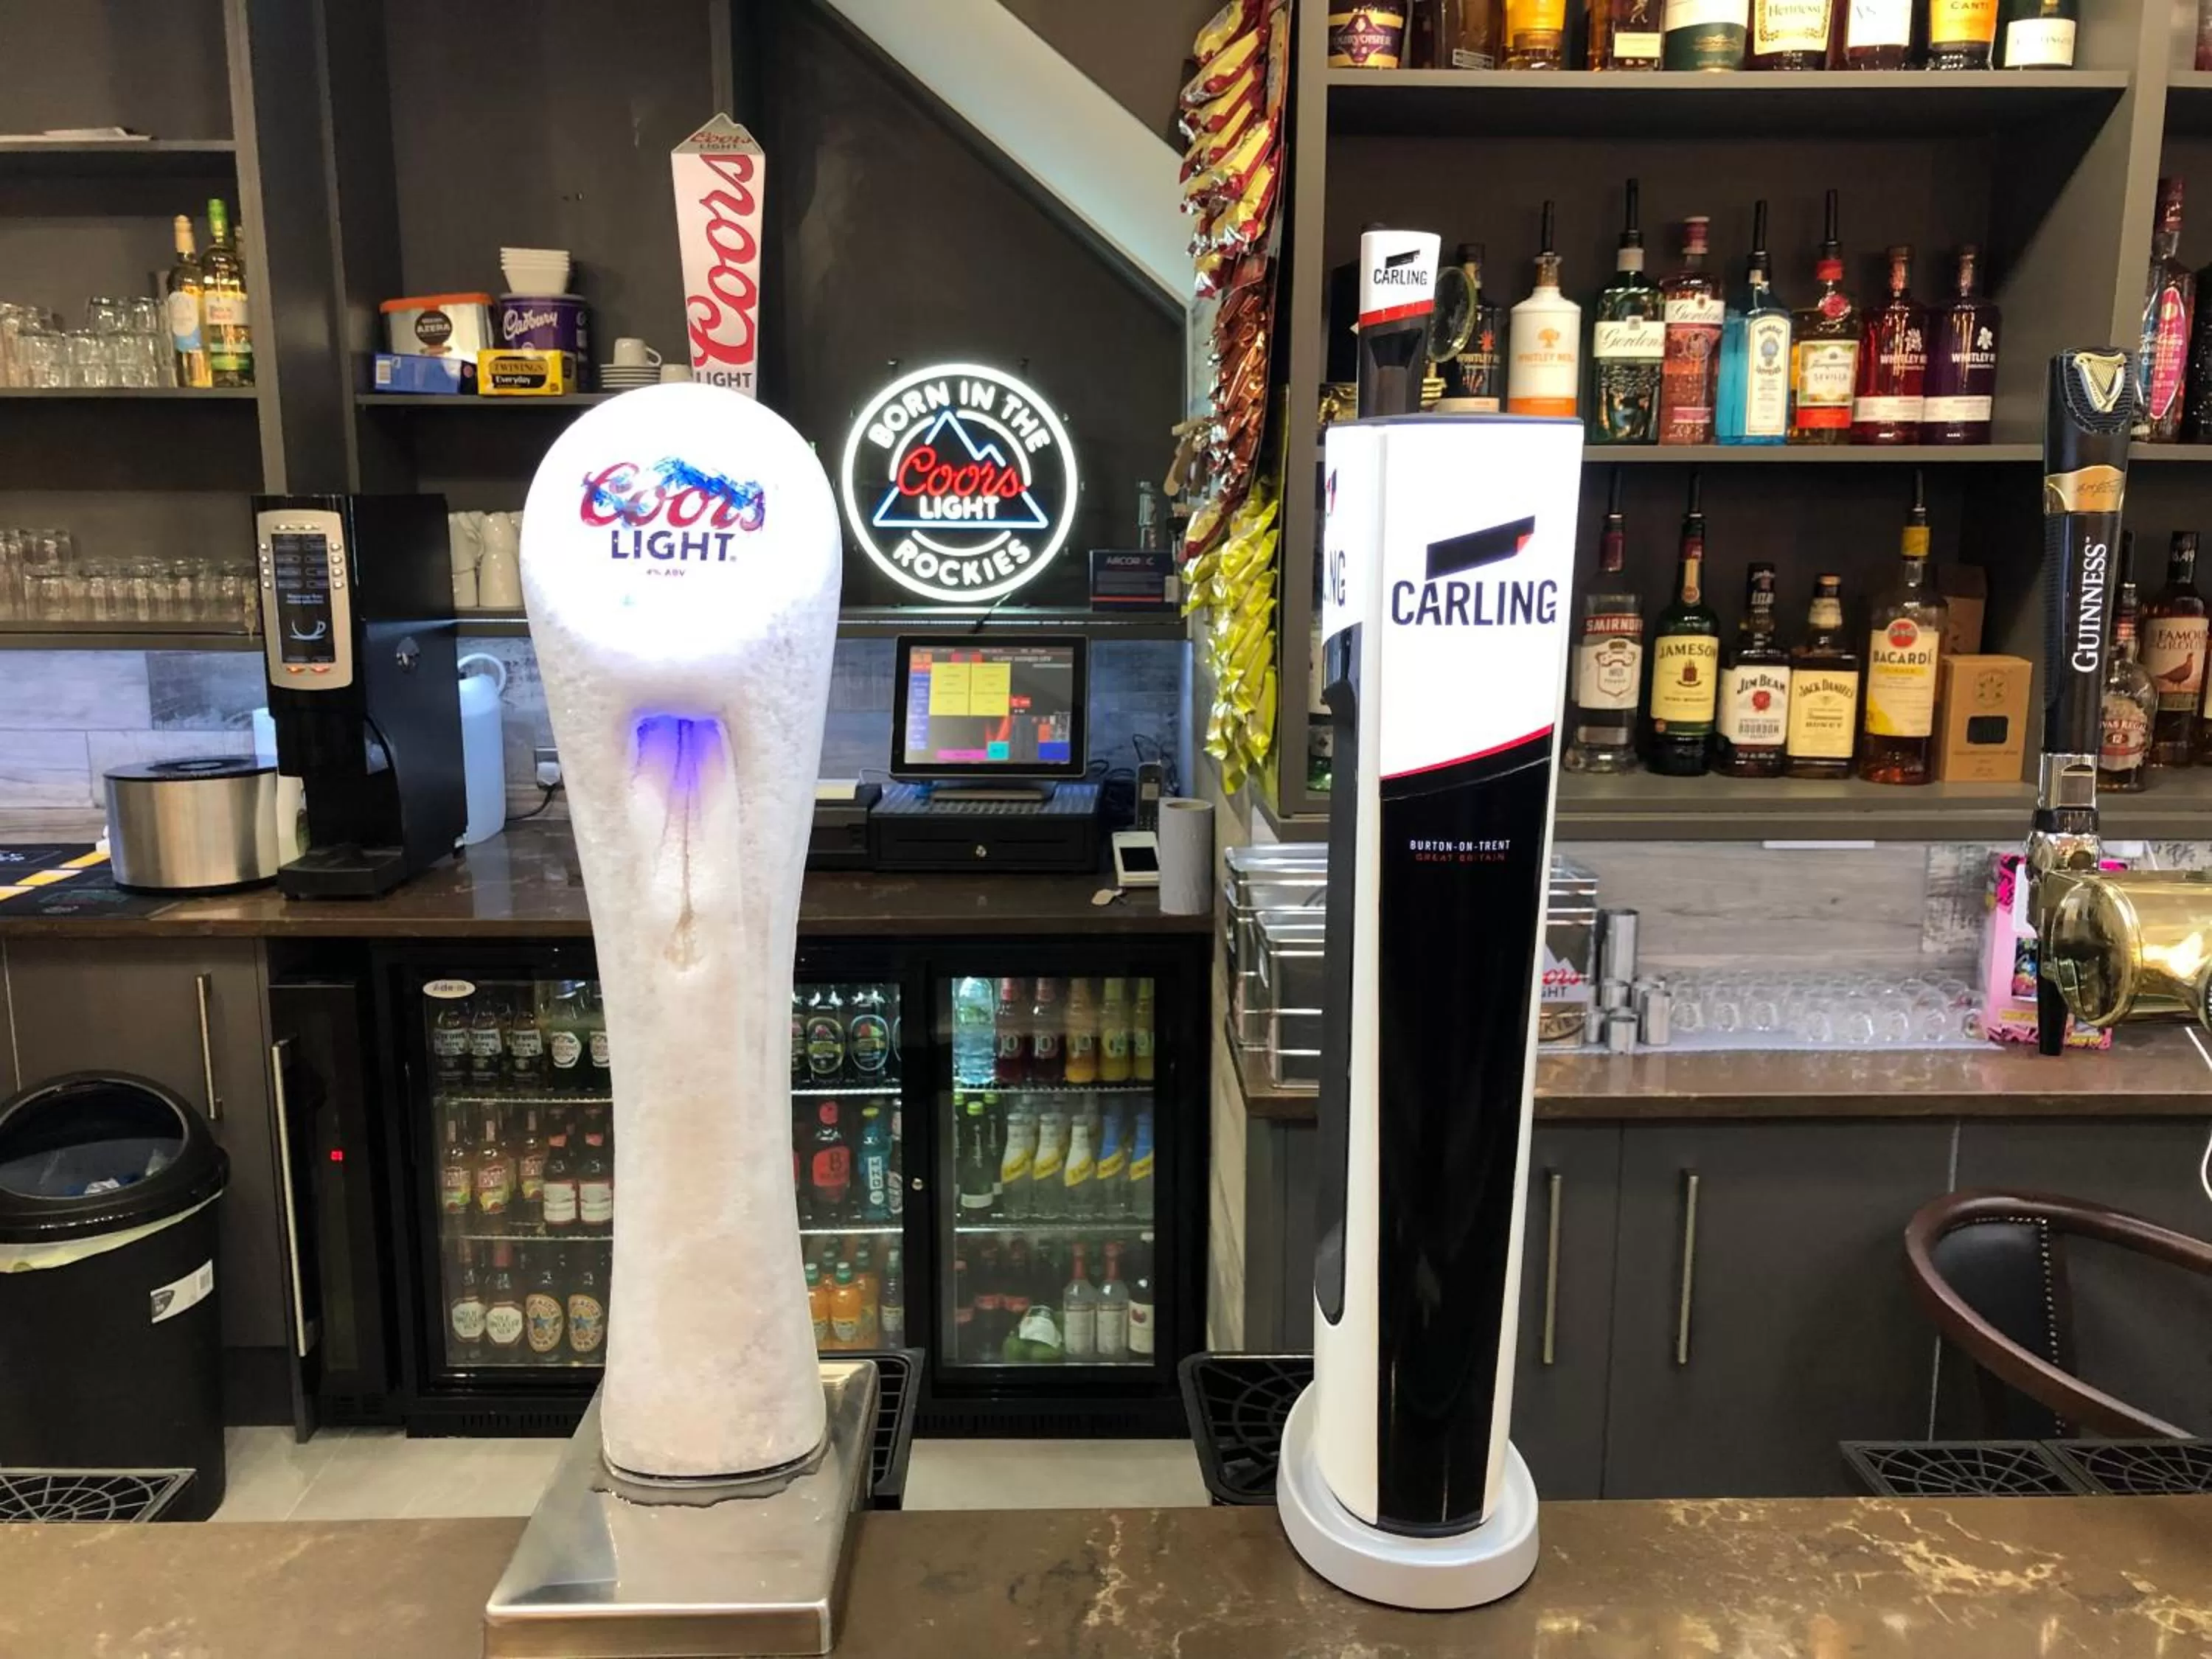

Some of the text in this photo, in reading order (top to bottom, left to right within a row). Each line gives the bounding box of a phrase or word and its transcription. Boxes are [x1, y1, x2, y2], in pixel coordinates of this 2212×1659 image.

[686, 154, 757, 366] Coors
[1373, 268, 1428, 285] CARLING
[503, 310, 558, 341] Cadbury
[495, 376, 531, 385] Everyday
[697, 372, 752, 389] LIGHT
[869, 380, 1051, 453] BORN IN THE
[896, 446, 1026, 498] Coors
[580, 461, 766, 532] Coors
[919, 495, 1000, 520] LIGHT
[611, 529, 736, 561] LIGHT
[664, 568, 686, 577] ABV
[892, 538, 1032, 586] ROCKIES
[1391, 579, 1558, 626] CARLING
[2073, 543, 2107, 673] GUINNESS
[1736, 673, 1786, 695] JIM BEAM
[1798, 681, 1821, 698] JACK
[2112, 734, 2123, 744] 12
[1409, 840, 1511, 852] BURTON-ON-TRENT
